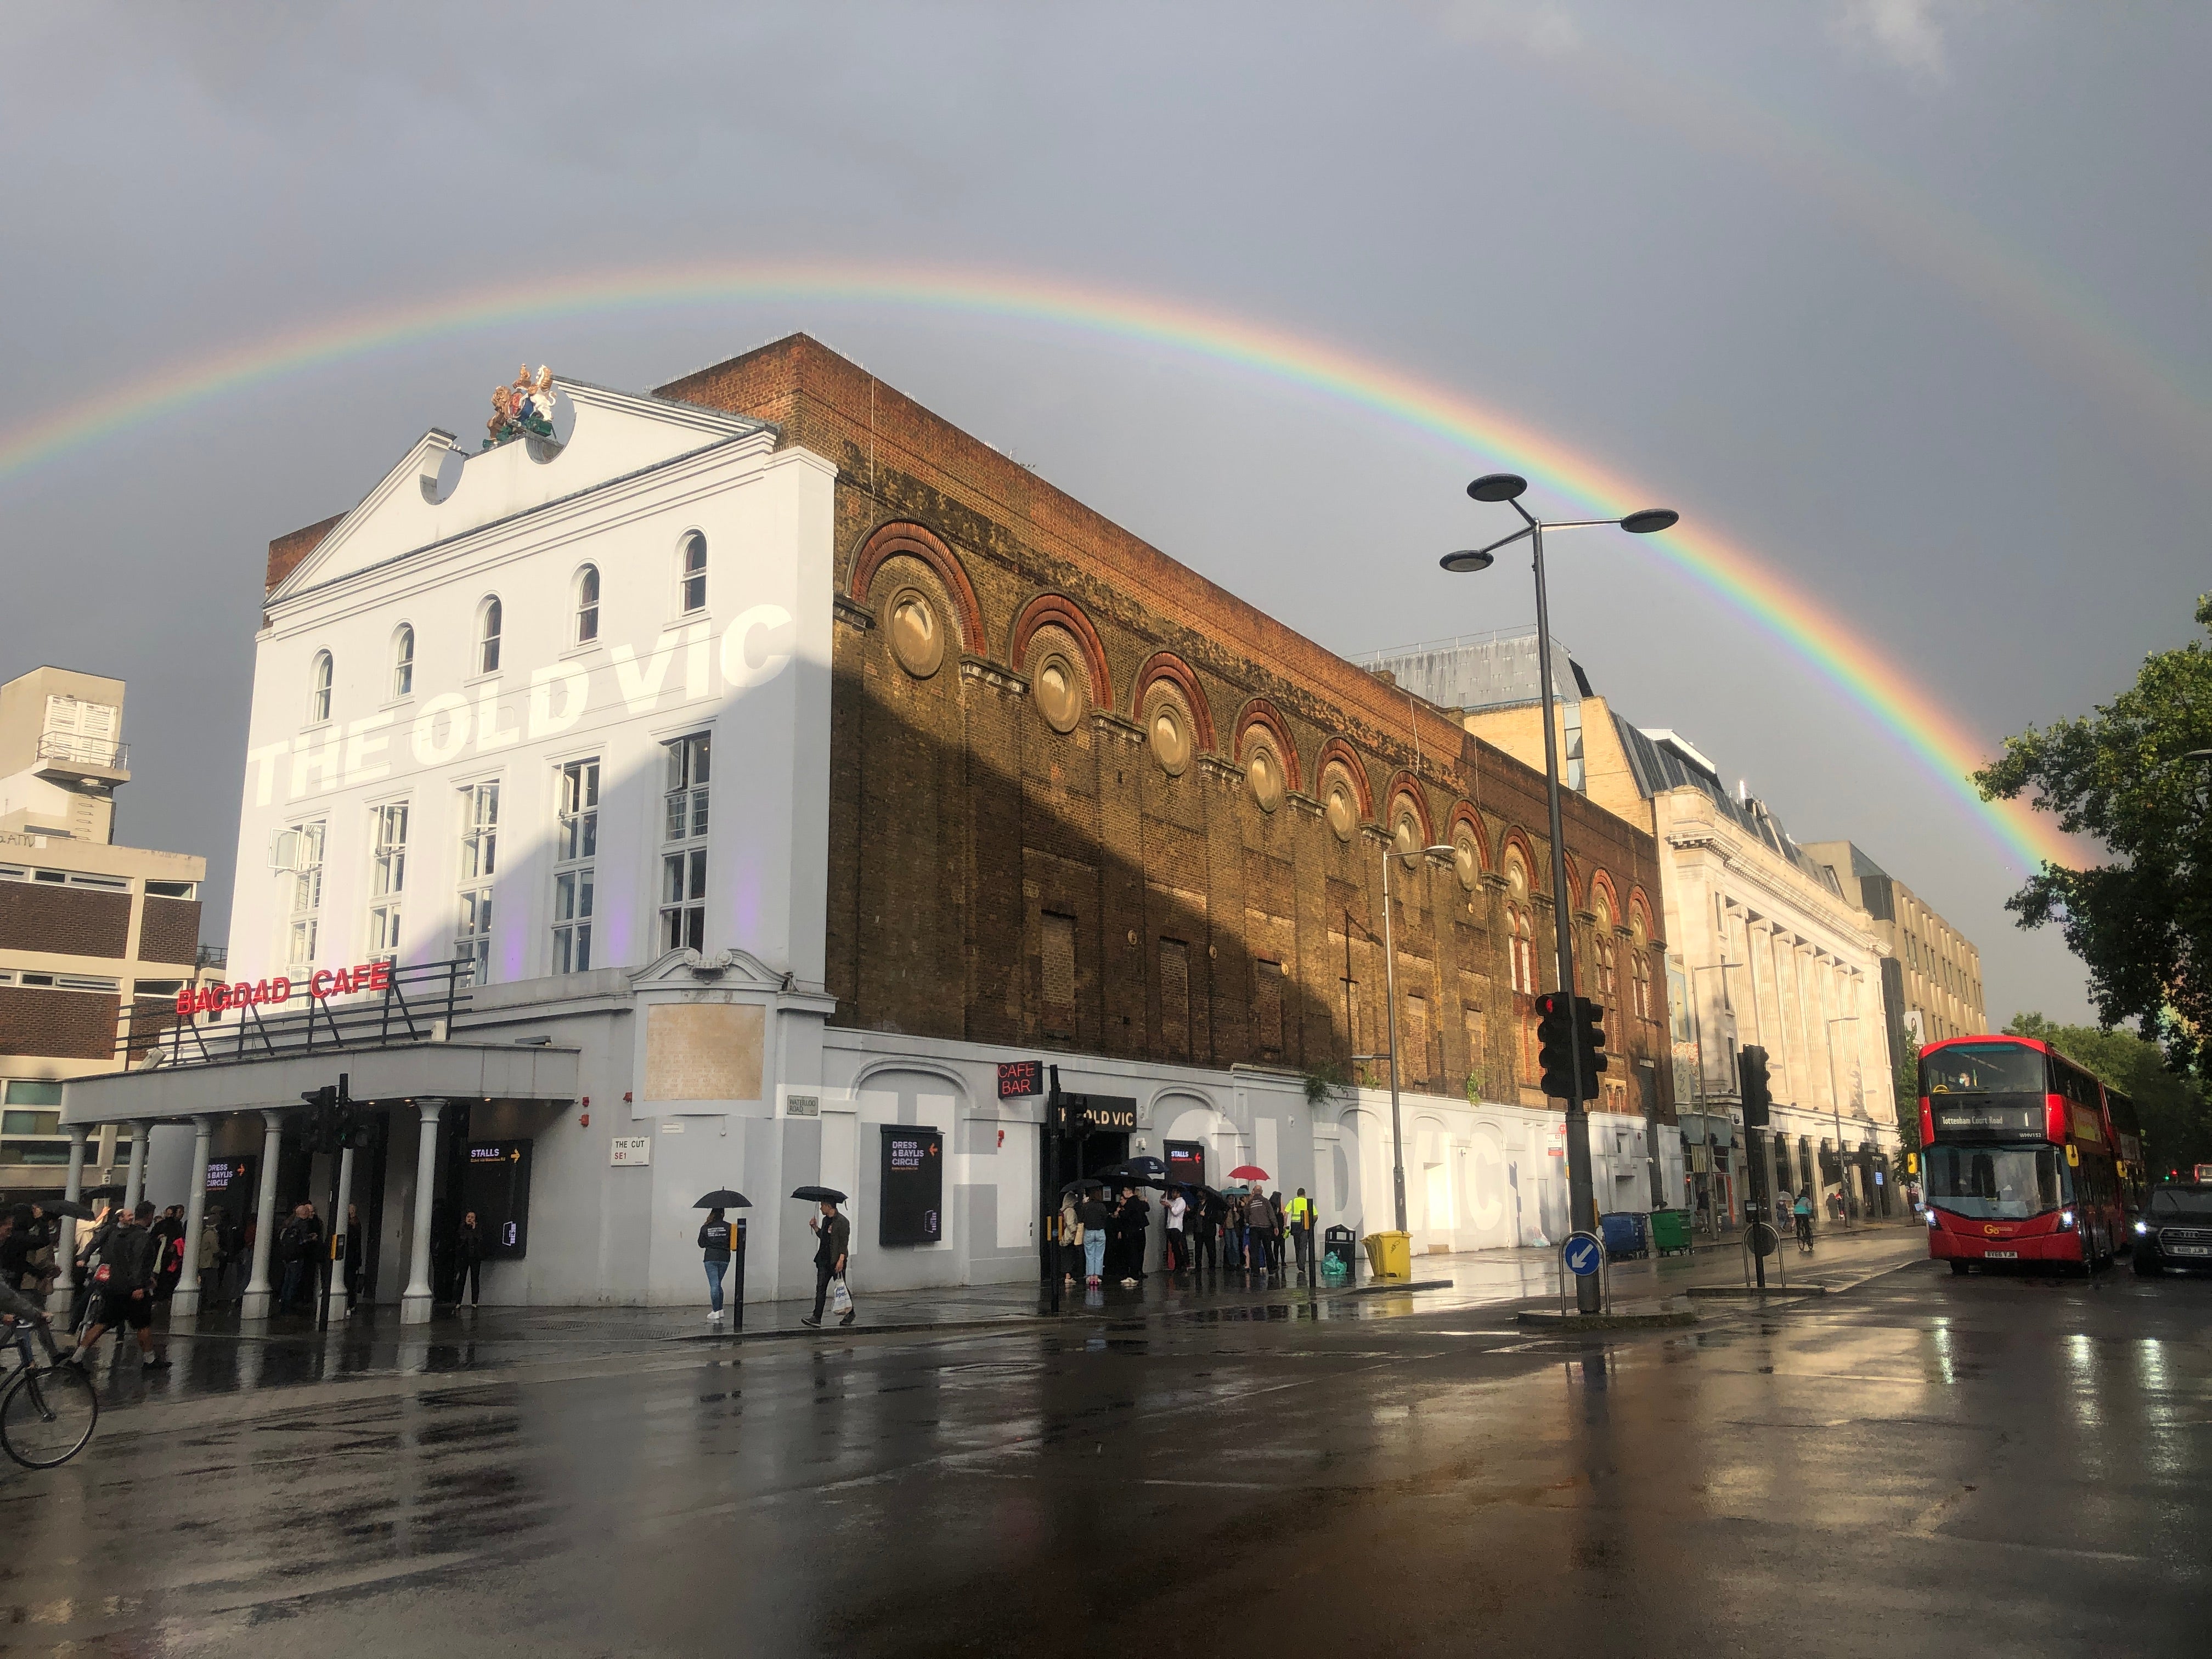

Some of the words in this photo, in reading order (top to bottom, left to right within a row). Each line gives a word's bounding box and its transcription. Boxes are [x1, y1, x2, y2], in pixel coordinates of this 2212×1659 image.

[247, 712, 393, 806] THE
[410, 660, 590, 765] OLD
[610, 603, 792, 714] VIC
[176, 977, 291, 1015] BAGDAD
[310, 961, 391, 999] CAFE
[998, 1062, 1035, 1078] CAFE
[1002, 1079, 1031, 1094] BAR
[1112, 1111, 1133, 1126] VIC
[1942, 1116, 1971, 1125] Tottenham
[1972, 1116, 1988, 1124] Court
[1989, 1116, 2003, 1125] Road
[2024, 1111, 2029, 1127] 1
[892, 1141, 918, 1149] DRESS
[471, 1148, 500, 1158] STALLS
[891, 1158, 919, 1166] CIRCLE
[211, 1171, 233, 1179] BAYLIS
[1984, 1224, 2000, 1234] Go
